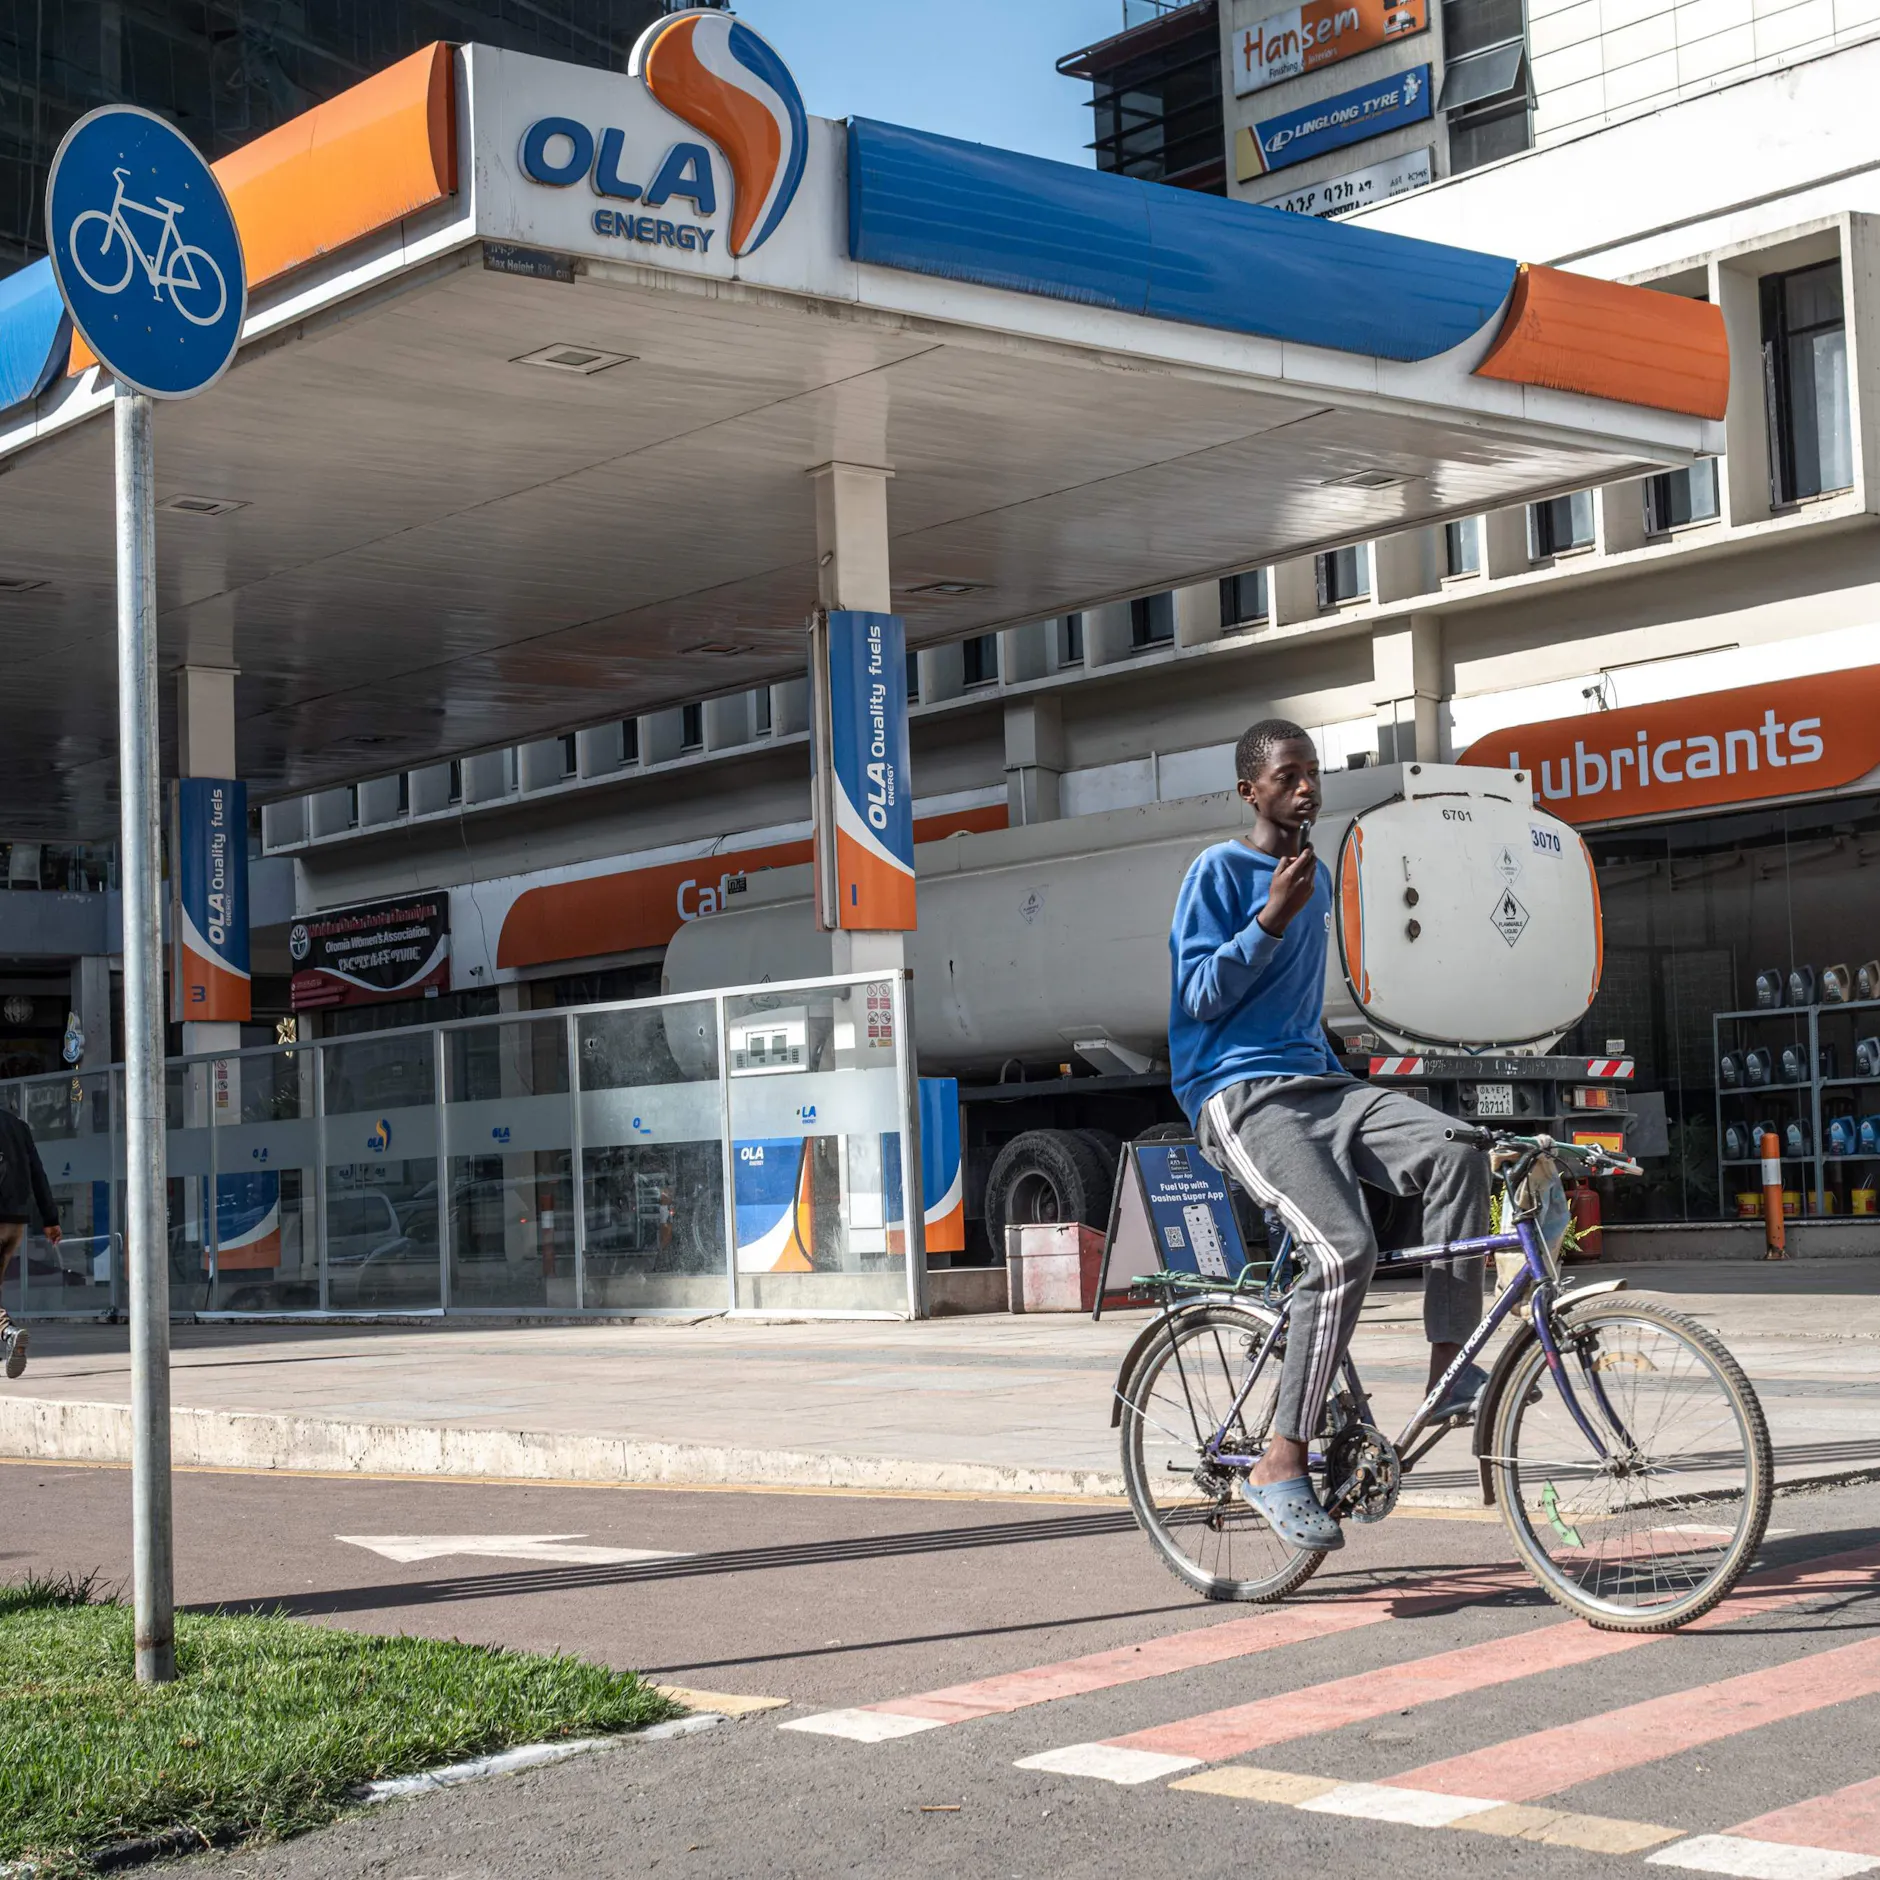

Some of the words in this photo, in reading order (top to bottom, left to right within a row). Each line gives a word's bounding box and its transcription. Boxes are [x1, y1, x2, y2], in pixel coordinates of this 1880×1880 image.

[1243, 6, 1359, 72] Hansem
[1268, 61, 1299, 79] Finishing
[1362, 90, 1400, 115] TYRE
[518, 116, 718, 218] OLA
[591, 208, 716, 253] ENERGY
[507, 259, 535, 274] Height
[868, 625, 881, 675] fuels
[869, 683, 886, 758] Quality
[211, 788, 223, 828] fuels
[868, 763, 888, 830] OLA
[1442, 809, 1473, 822] 6701
[212, 832, 227, 890] Quality
[1532, 830, 1561, 852] 3070
[677, 869, 744, 920] Caf
[208, 893, 225, 945] OLA
[325, 937, 351, 953] Oromia
[351, 931, 384, 949] Women's
[1480, 1101, 1505, 1114] 28711
[741, 1146, 764, 1161] OLA
[1151, 1194, 1182, 1203] Dashen
[1182, 1192, 1206, 1202] Super
[1207, 1191, 1224, 1200] App
[1160, 1183, 1178, 1191] Fuel
[1178, 1182, 1189, 1192] Up
[1190, 1181, 1209, 1190] with
[1437, 1348, 1467, 1387] FLYING
[1462, 1314, 1493, 1354] PIGEON
